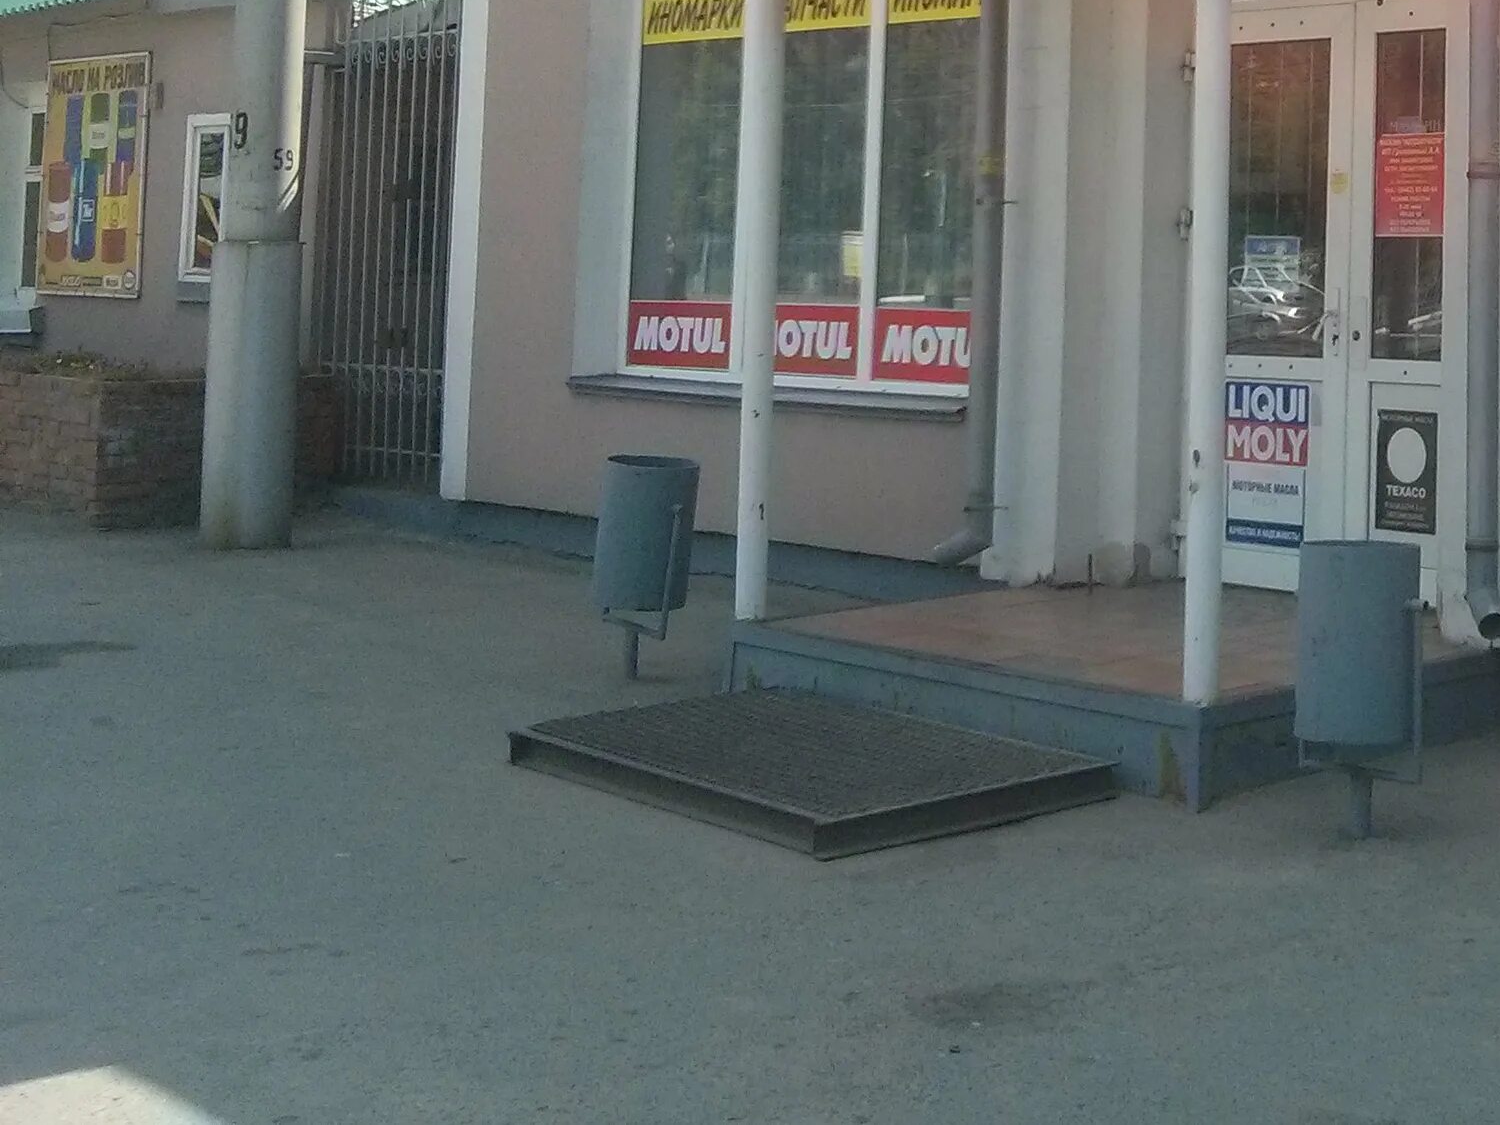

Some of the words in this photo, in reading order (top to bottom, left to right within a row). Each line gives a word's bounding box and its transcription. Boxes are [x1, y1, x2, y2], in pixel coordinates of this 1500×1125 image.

[234, 112, 248, 150] 9
[273, 148, 294, 171] 59
[633, 315, 726, 354] MOTUL
[775, 319, 853, 360] OTUL
[881, 324, 971, 368] MOTU
[1228, 384, 1306, 423] LIQUI
[1227, 424, 1309, 463] MOLY
[1385, 484, 1427, 499] TEXACO
